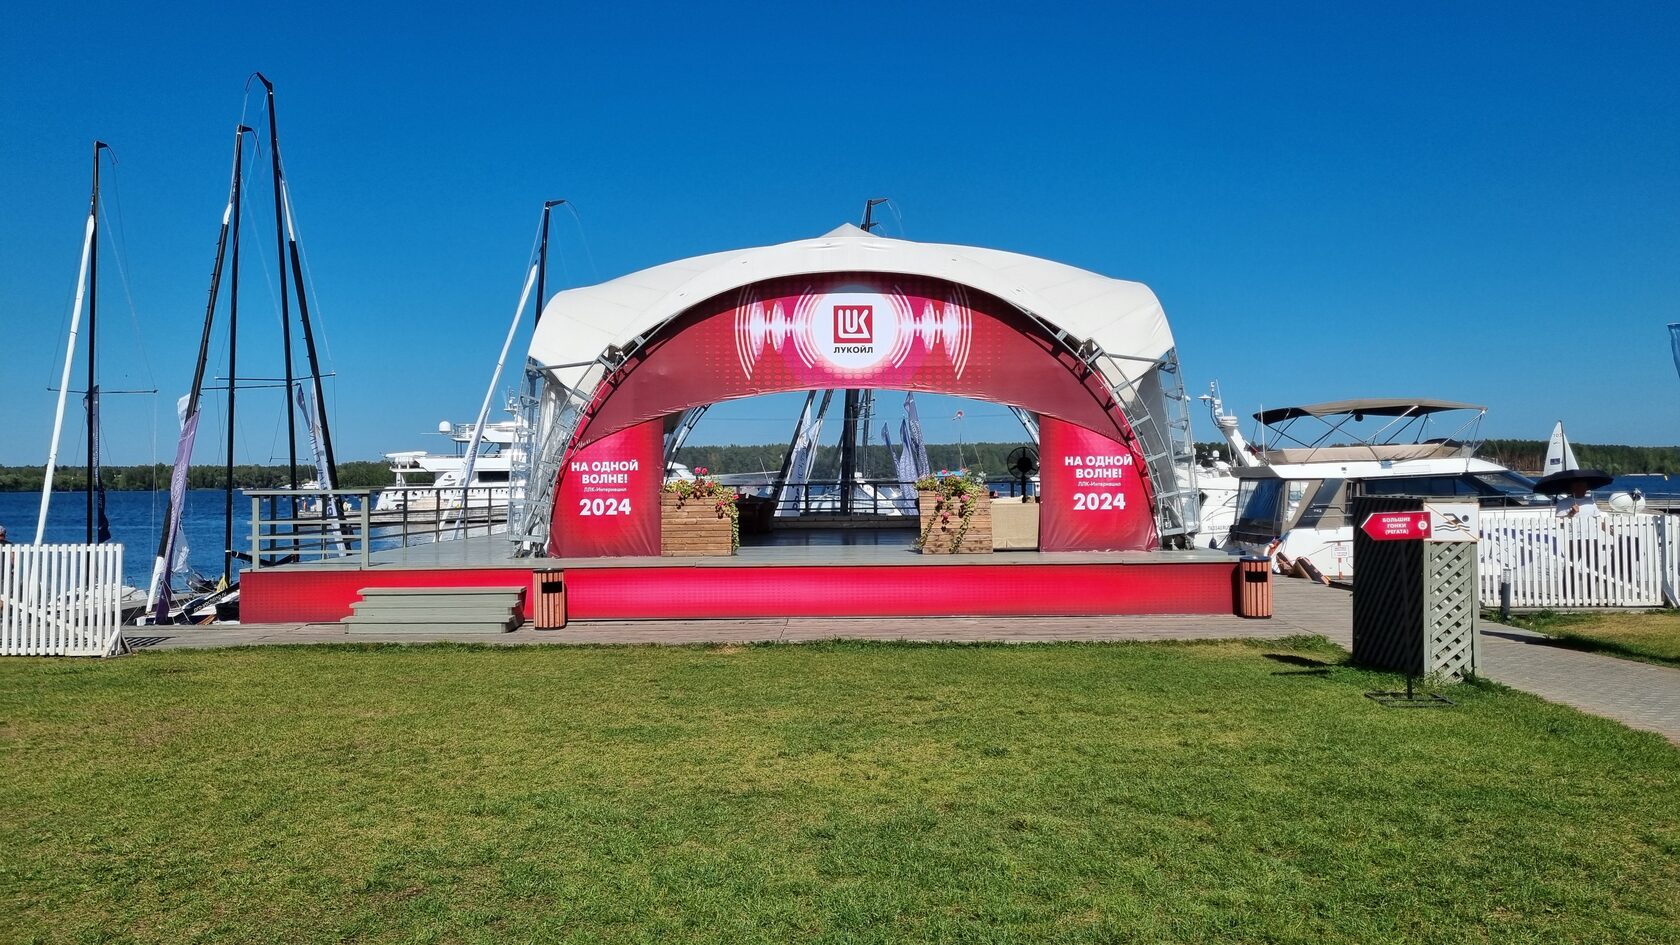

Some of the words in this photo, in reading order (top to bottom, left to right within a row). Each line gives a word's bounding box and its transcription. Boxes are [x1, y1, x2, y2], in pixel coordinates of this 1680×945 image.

[838, 309, 871, 339] LUK
[833, 345, 873, 353] ЛУКОЙЛ
[571, 461, 589, 472] НА
[591, 459, 638, 473] ОДНОЙ
[1064, 456, 1083, 466] НА
[1085, 454, 1133, 467] ОДНОЙ
[582, 474, 628, 484] ВОЛНЕ!
[1075, 468, 1122, 478] ВОЛНЕ!
[579, 498, 632, 516] 2024
[1073, 493, 1126, 510] 2024
